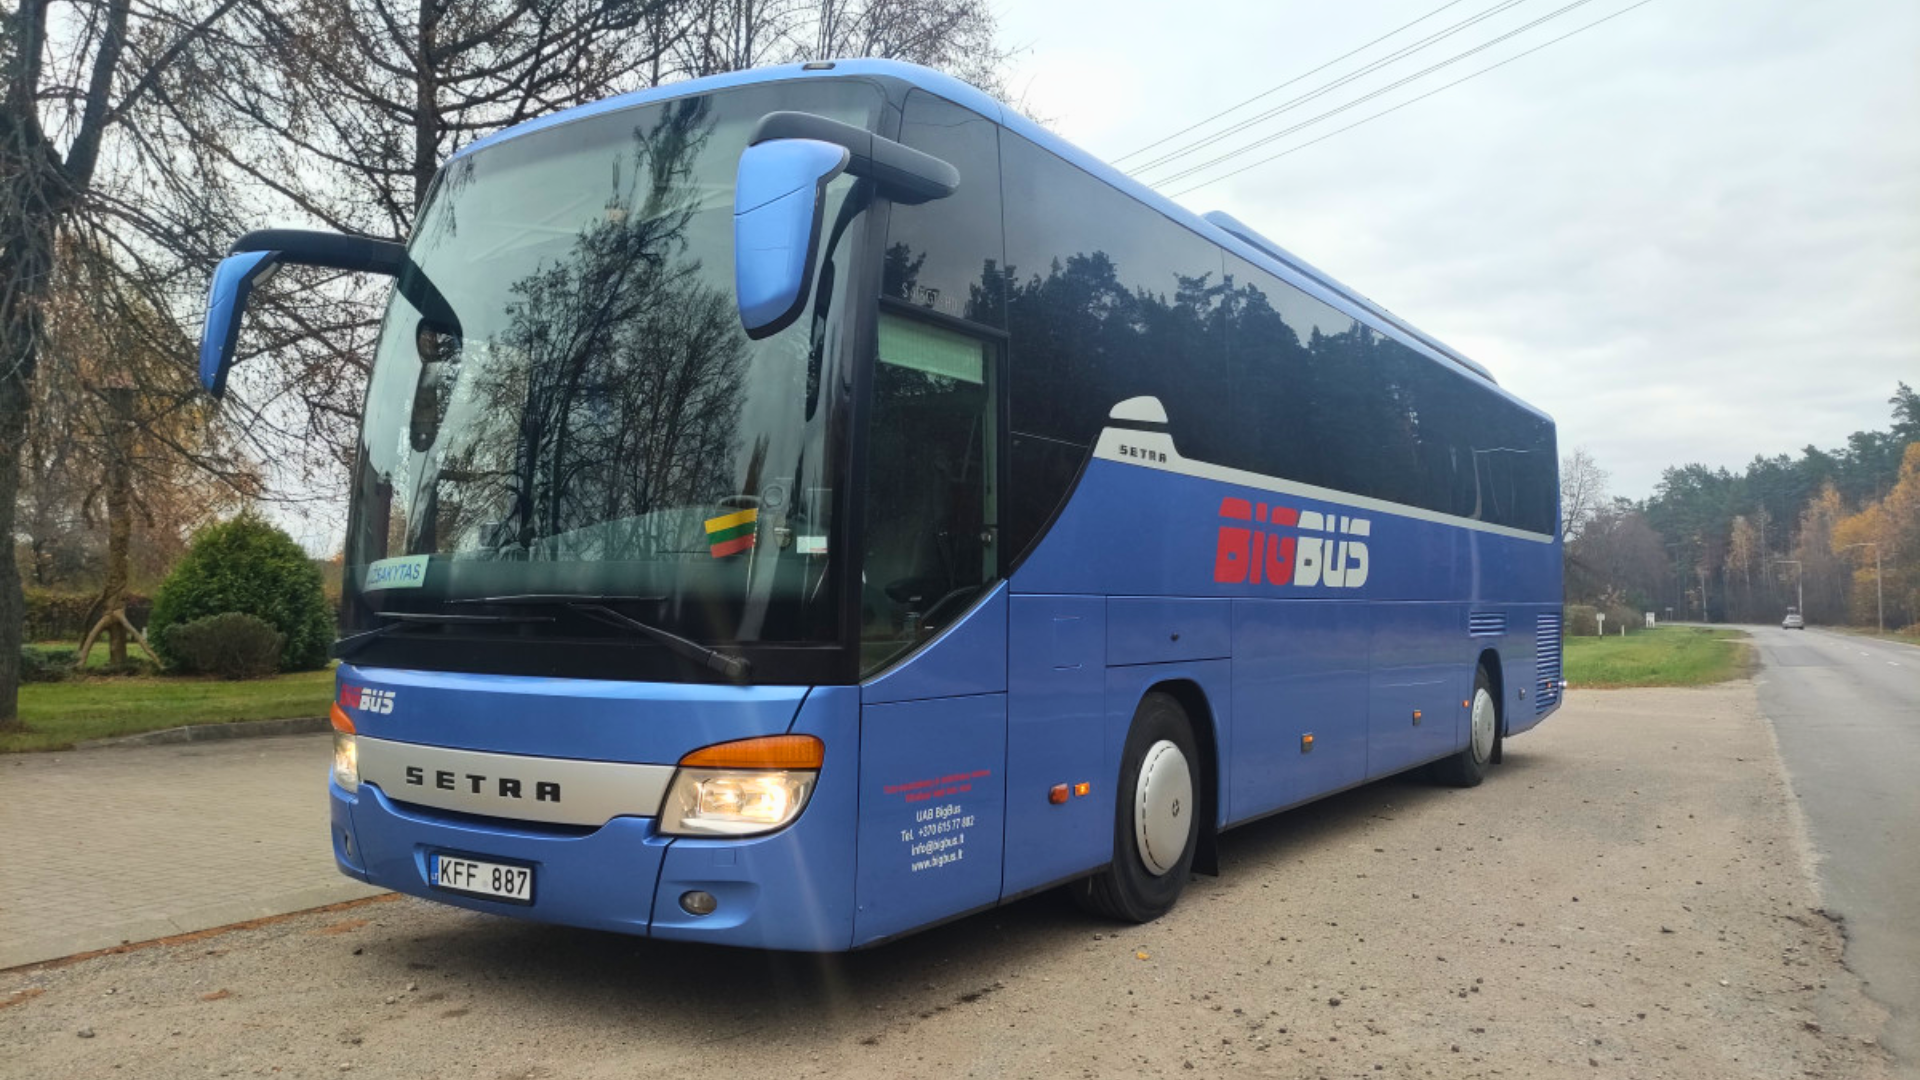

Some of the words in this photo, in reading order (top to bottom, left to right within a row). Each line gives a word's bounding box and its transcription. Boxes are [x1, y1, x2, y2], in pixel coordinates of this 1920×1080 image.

[1119, 444, 1167, 463] SETRA
[406, 766, 561, 802] SETRA
[916, 808, 933, 822] UAB
[935, 804, 961, 819] BigBus
[918, 823, 937, 837] +370
[937, 820, 951, 834] 615
[952, 818, 961, 830] 77
[911, 833, 964, 856] info@bigbus.lt
[911, 849, 963, 872] www.bigbus.lt
[441, 859, 479, 888] KFF
[492, 867, 528, 896] 887
